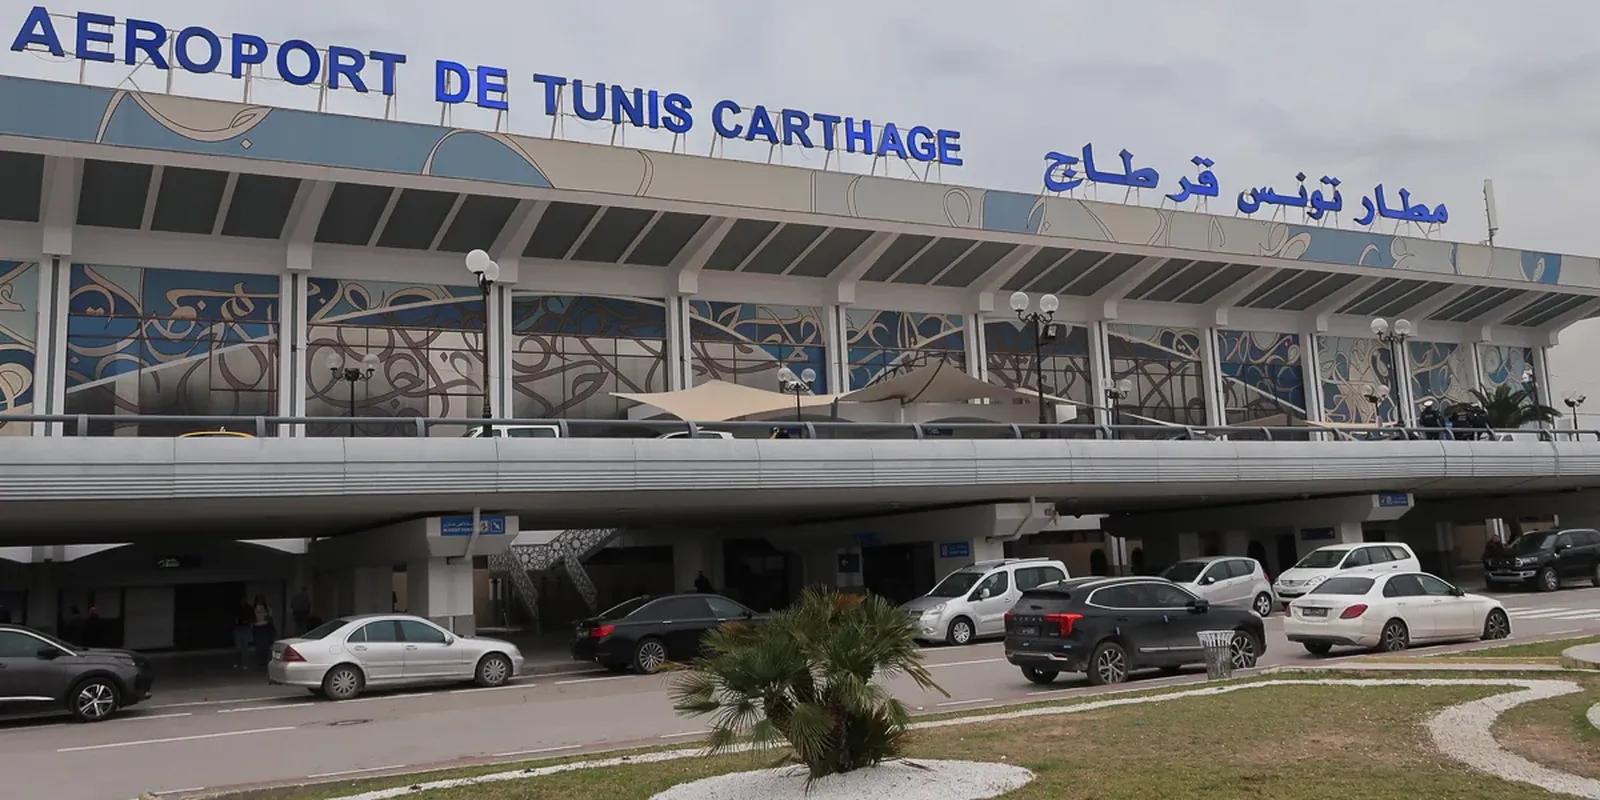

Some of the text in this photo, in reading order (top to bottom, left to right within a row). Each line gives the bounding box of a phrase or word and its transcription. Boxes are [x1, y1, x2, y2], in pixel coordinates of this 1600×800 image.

[10, 6, 964, 166] AEROPORT DE TUNIS CARTHAGE
[1044, 142, 1449, 226] مطار تونس قرطاج
